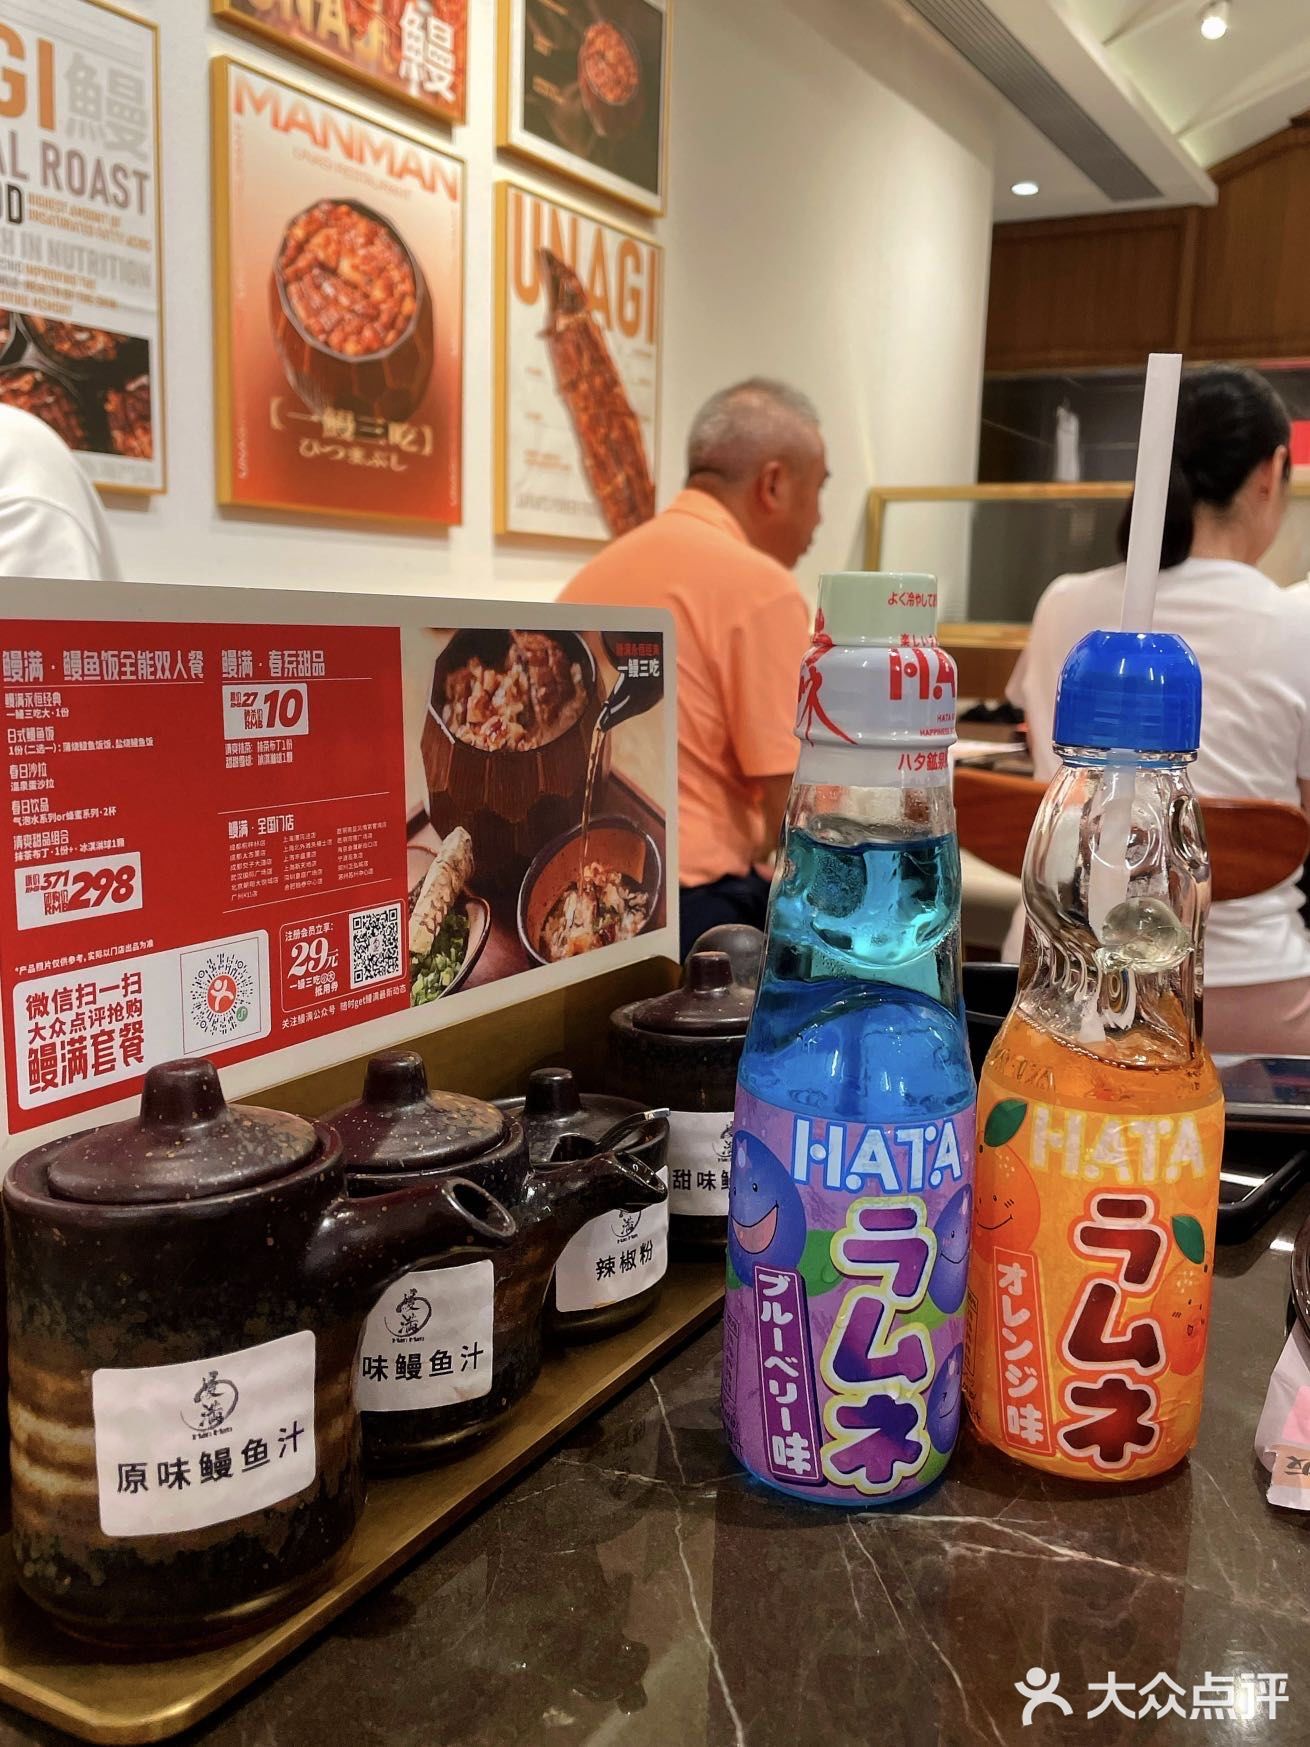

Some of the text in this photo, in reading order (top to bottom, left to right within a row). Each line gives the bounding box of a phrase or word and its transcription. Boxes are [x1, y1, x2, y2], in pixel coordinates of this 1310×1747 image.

[234, 77, 458, 203] MANMAN
[41, 140, 149, 216] ROAST
[241, 691, 259, 707] 27
[263, 688, 305, 729] 10
[9, 761, 48, 780] 春日沙拉
[11, 797, 49, 816] 春日饮品
[41, 869, 71, 891] 371
[67, 865, 136, 911] 298
[287, 937, 340, 979] 29元
[25, 971, 144, 1023] 微信扫一扫
[27, 998, 145, 1045] 大众点评抢购
[28, 1021, 146, 1096] 鳗满套餐
[790, 1114, 964, 1194] HATA
[1029, 1102, 1208, 1184] HATA
[595, 1240, 653, 1282] 辣椒粉
[822, 1198, 936, 1493] ラムネ
[996, 1262, 1046, 1446] オレンジ味
[1057, 1192, 1168, 1471] ラムネ
[757, 1272, 813, 1477] ブルーベリー味
[116, 1420, 305, 1495] 原味鳗鱼汁
